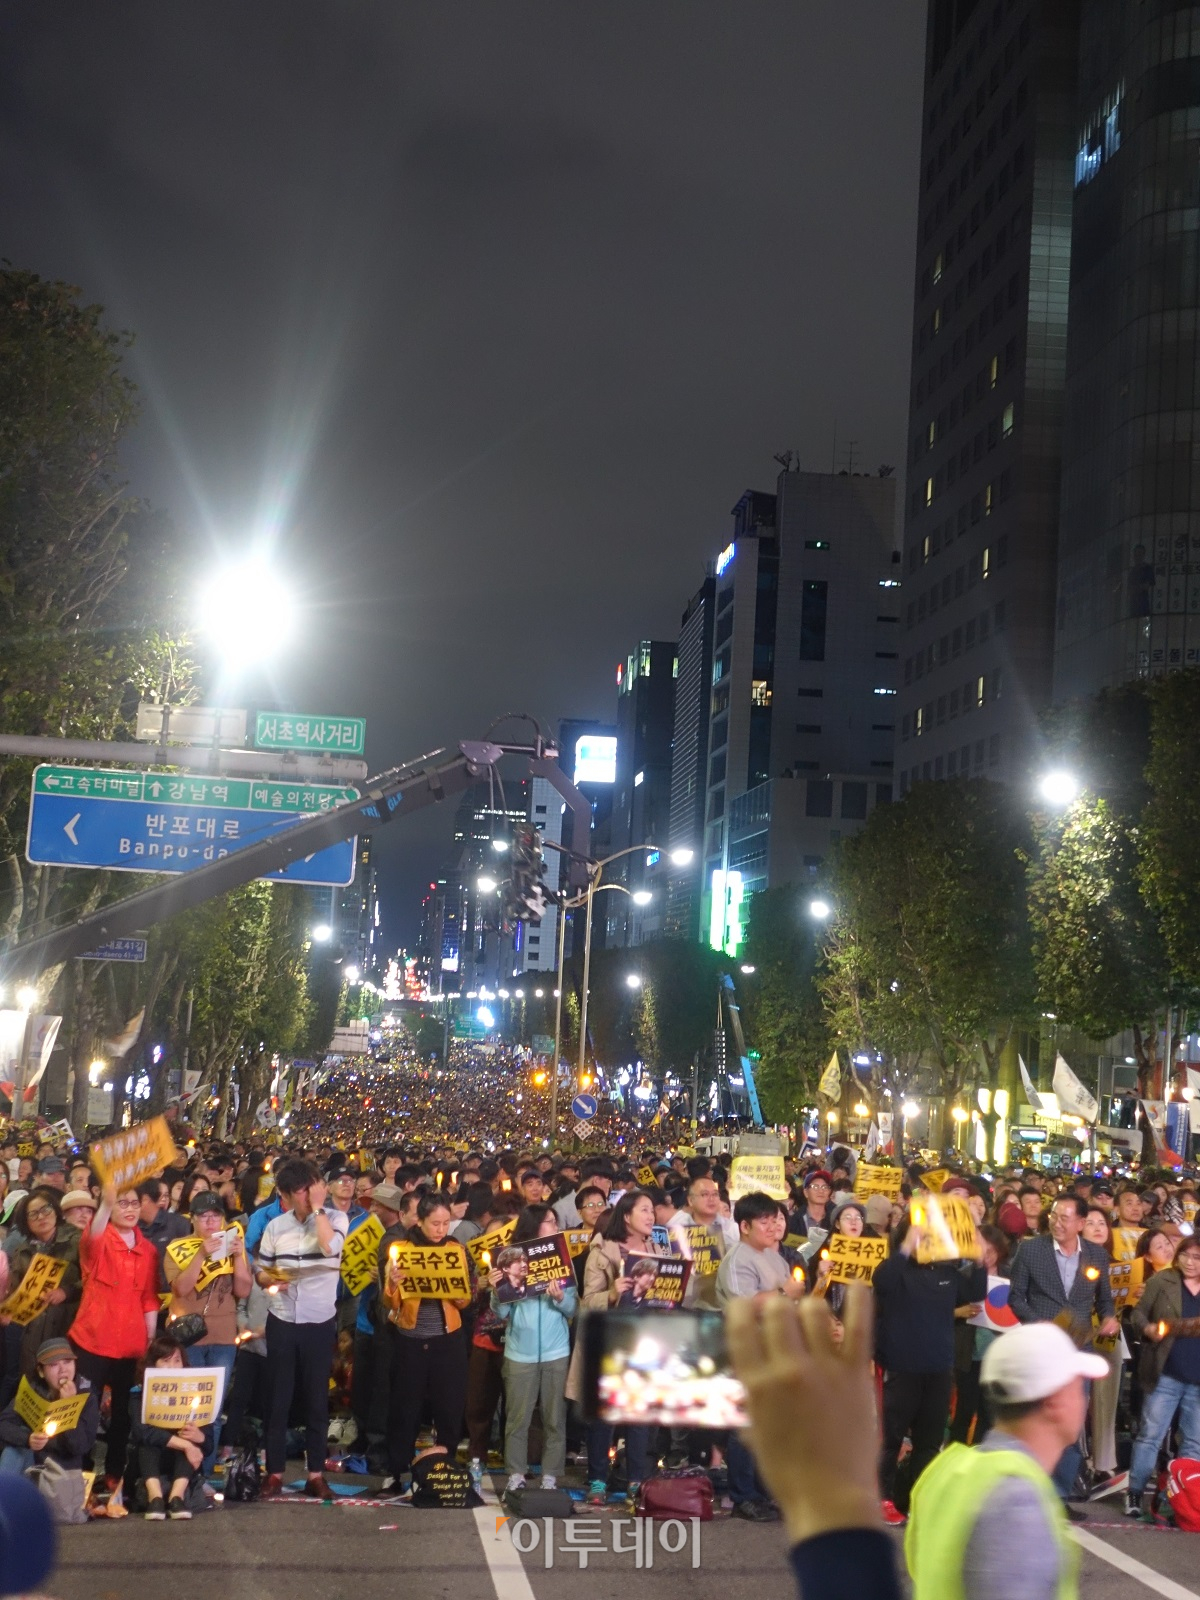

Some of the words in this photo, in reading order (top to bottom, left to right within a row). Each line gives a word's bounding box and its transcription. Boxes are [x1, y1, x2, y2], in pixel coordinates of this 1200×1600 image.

[261, 719, 358, 747] 서초역사거리
[60, 776, 140, 798] 고속터미널
[168, 783, 229, 802] 강남역
[254, 790, 332, 810] 예술의전당
[146, 814, 240, 840] 반포대로
[119, 838, 228, 860] Banpo-da
[856, 1169, 900, 1184] 조국수호
[528, 1243, 556, 1256] 조국수호
[831, 1238, 885, 1260] 조국수호
[396, 1252, 463, 1270] 조국수호
[528, 1255, 561, 1273] 우리가
[660, 1264, 684, 1275] 조국수호
[526, 1265, 571, 1287] 조국이다
[829, 1260, 873, 1281] 검찰개
[401, 1276, 467, 1294] 검찰개혁
[654, 1276, 682, 1290] 우리가
[643, 1288, 683, 1302] 조국이다
[152, 1382, 178, 1393] 우리가
[181, 1381, 213, 1392] 조국이다
[151, 1396, 177, 1407] 조국을
[426, 1472, 448, 1480] Design
[433, 1482, 451, 1490] Design
